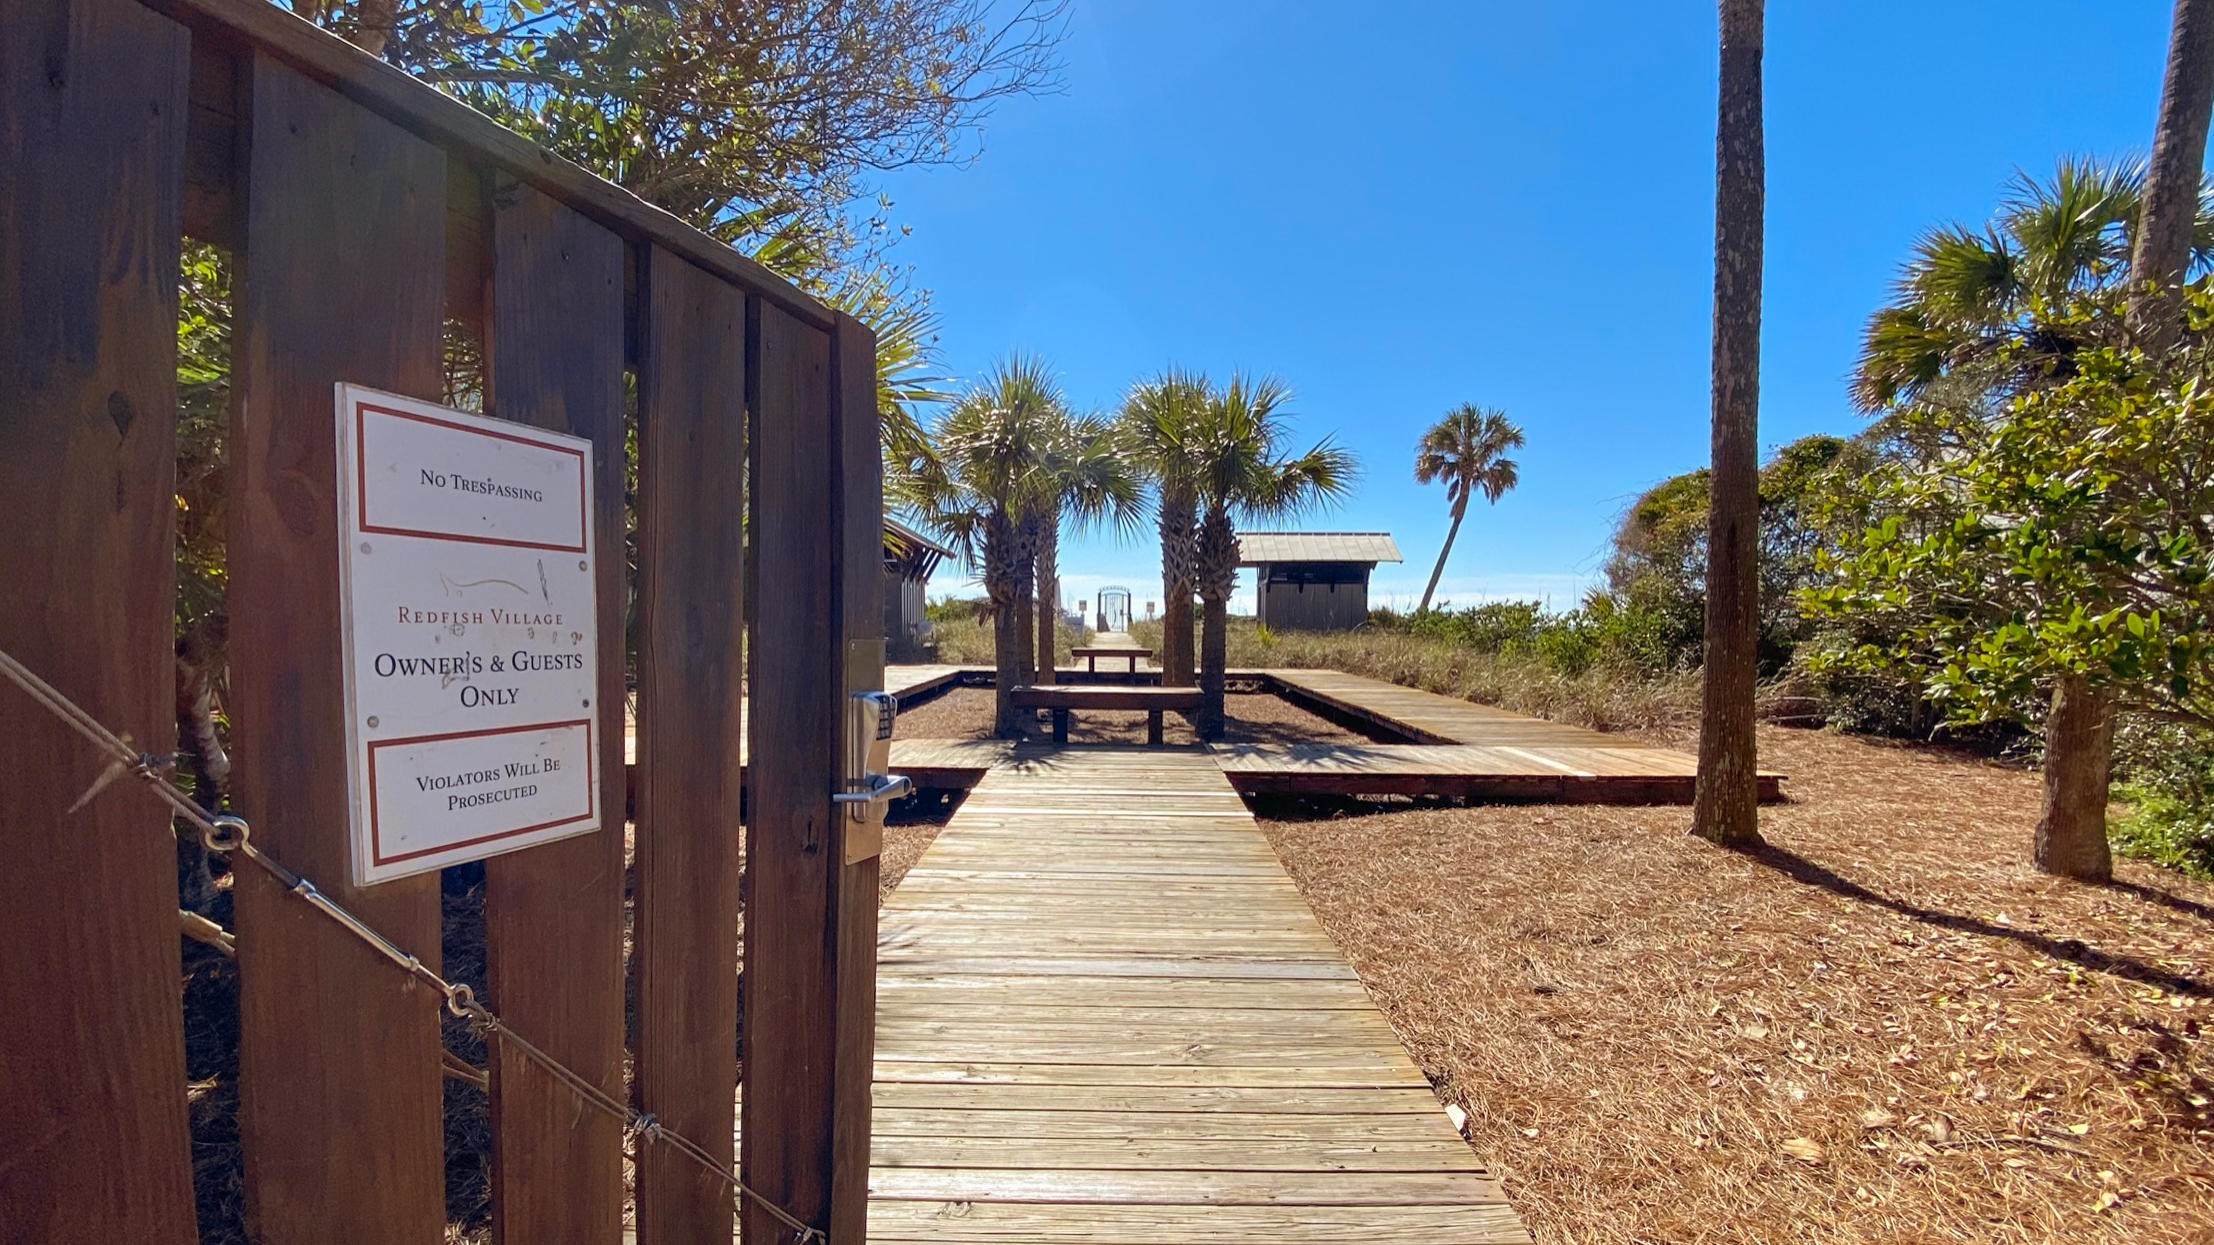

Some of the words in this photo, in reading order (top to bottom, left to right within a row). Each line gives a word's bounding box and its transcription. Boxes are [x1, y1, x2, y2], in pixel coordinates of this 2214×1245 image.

[420, 469, 446, 488] NO
[450, 474, 543, 502] TRESPASSING
[398, 606, 483, 624] REDFISH
[491, 608, 563, 625] VILLAGE
[374, 650, 482, 677] OWNER'S
[490, 658, 504, 673] &
[512, 650, 583, 672] GUESTS
[460, 686, 519, 708] ONLY
[416, 769, 500, 792] VIOLATORS
[504, 762, 539, 779] WILL
[543, 758, 561, 772] BE
[448, 784, 538, 811] PROSECUTED
